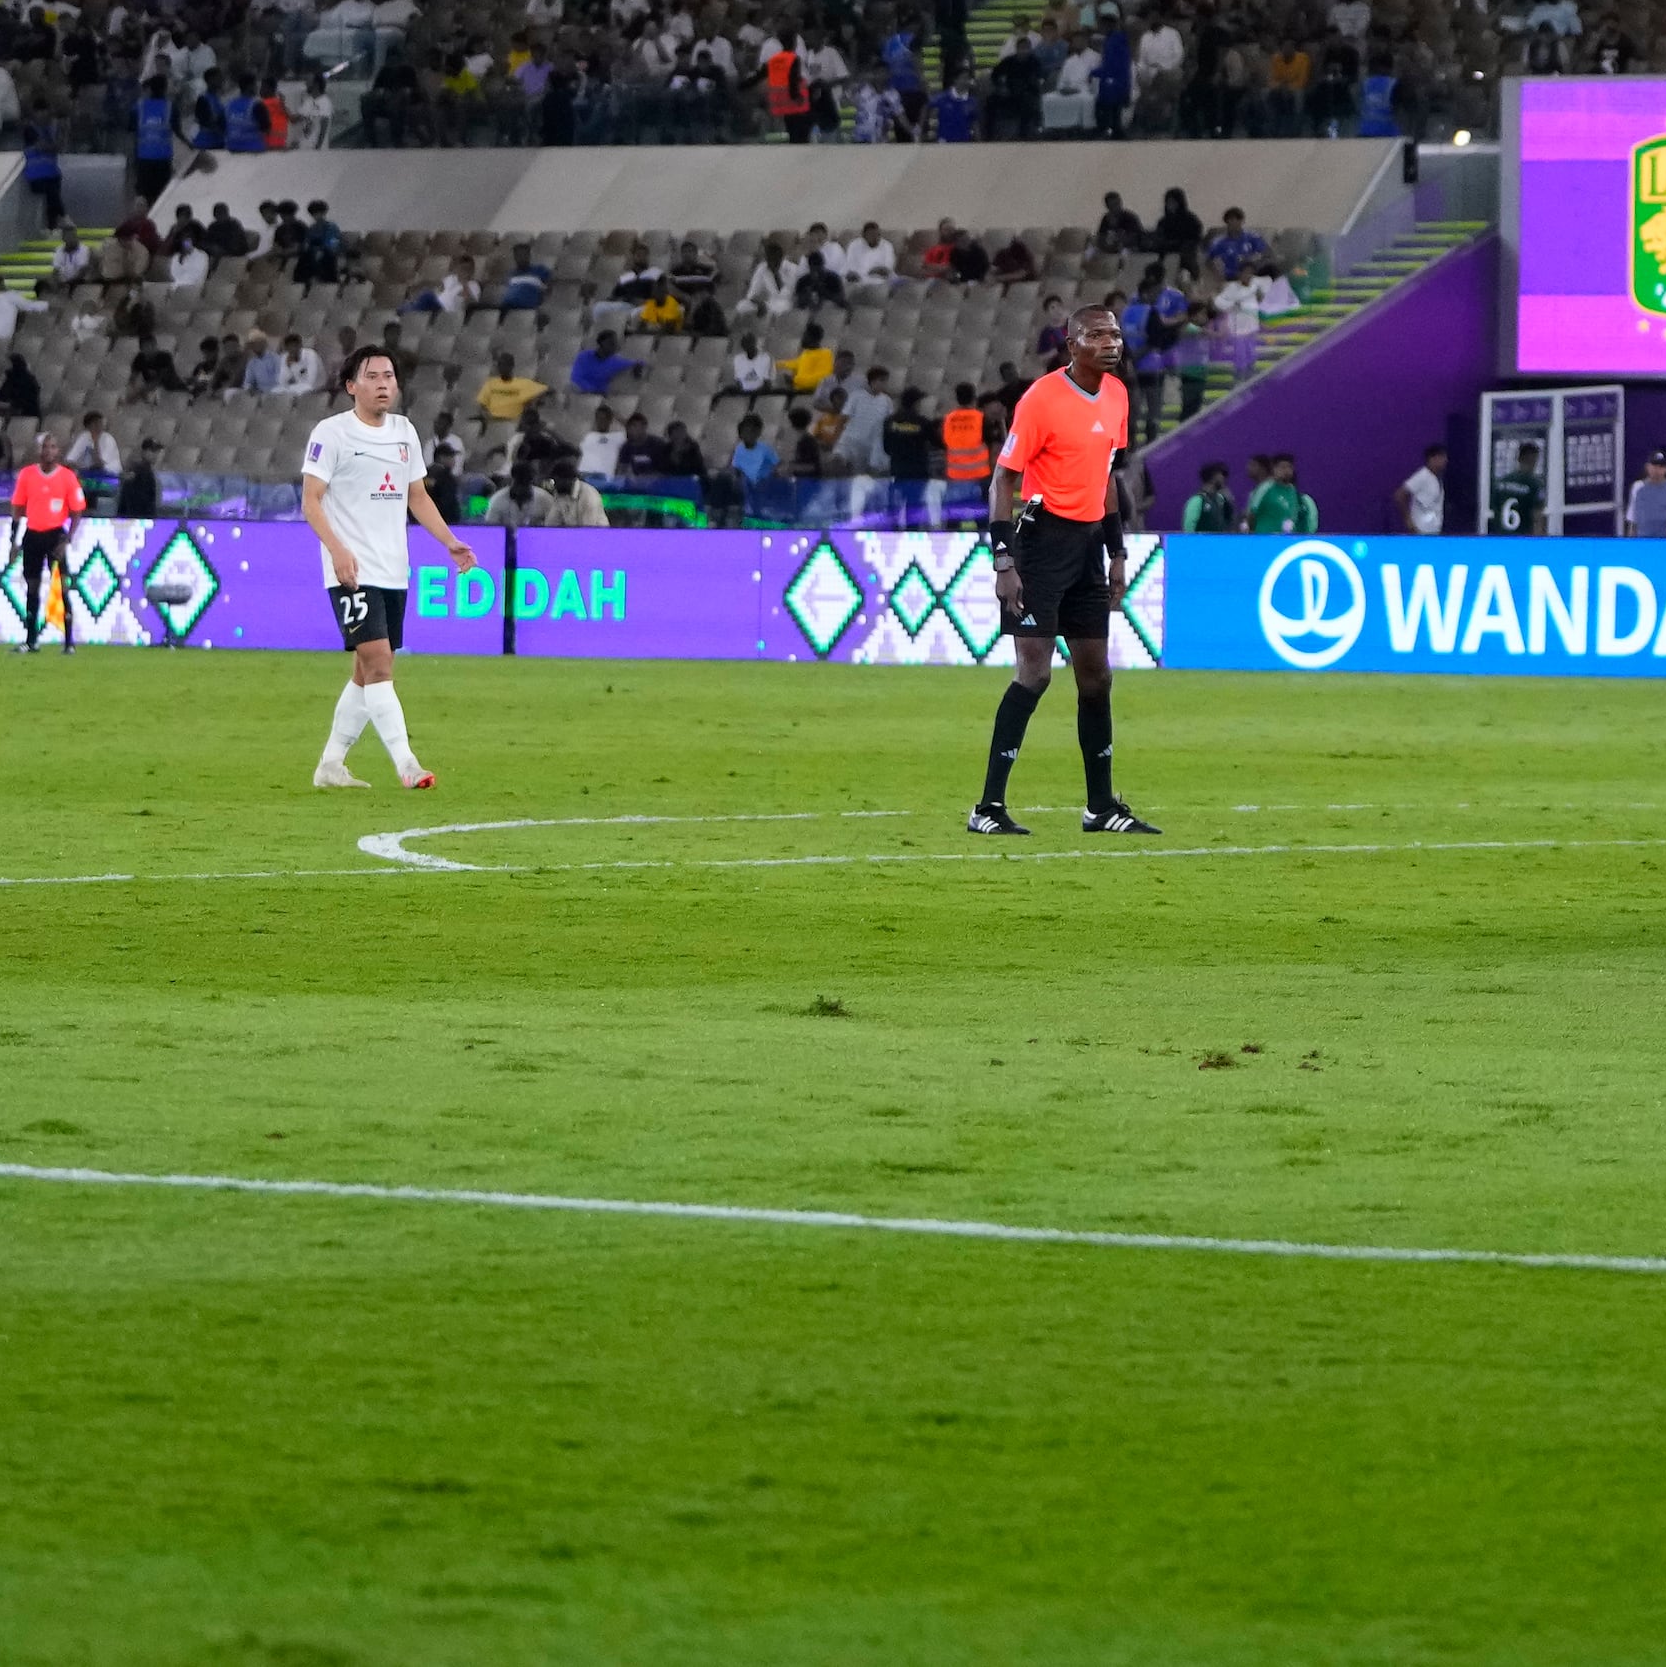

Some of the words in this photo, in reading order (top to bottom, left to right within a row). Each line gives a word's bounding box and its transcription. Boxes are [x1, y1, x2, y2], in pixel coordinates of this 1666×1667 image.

[1502, 497, 1521, 530] 6
[340, 592, 368, 624] 25
[408, 565, 626, 621] EDDAH
